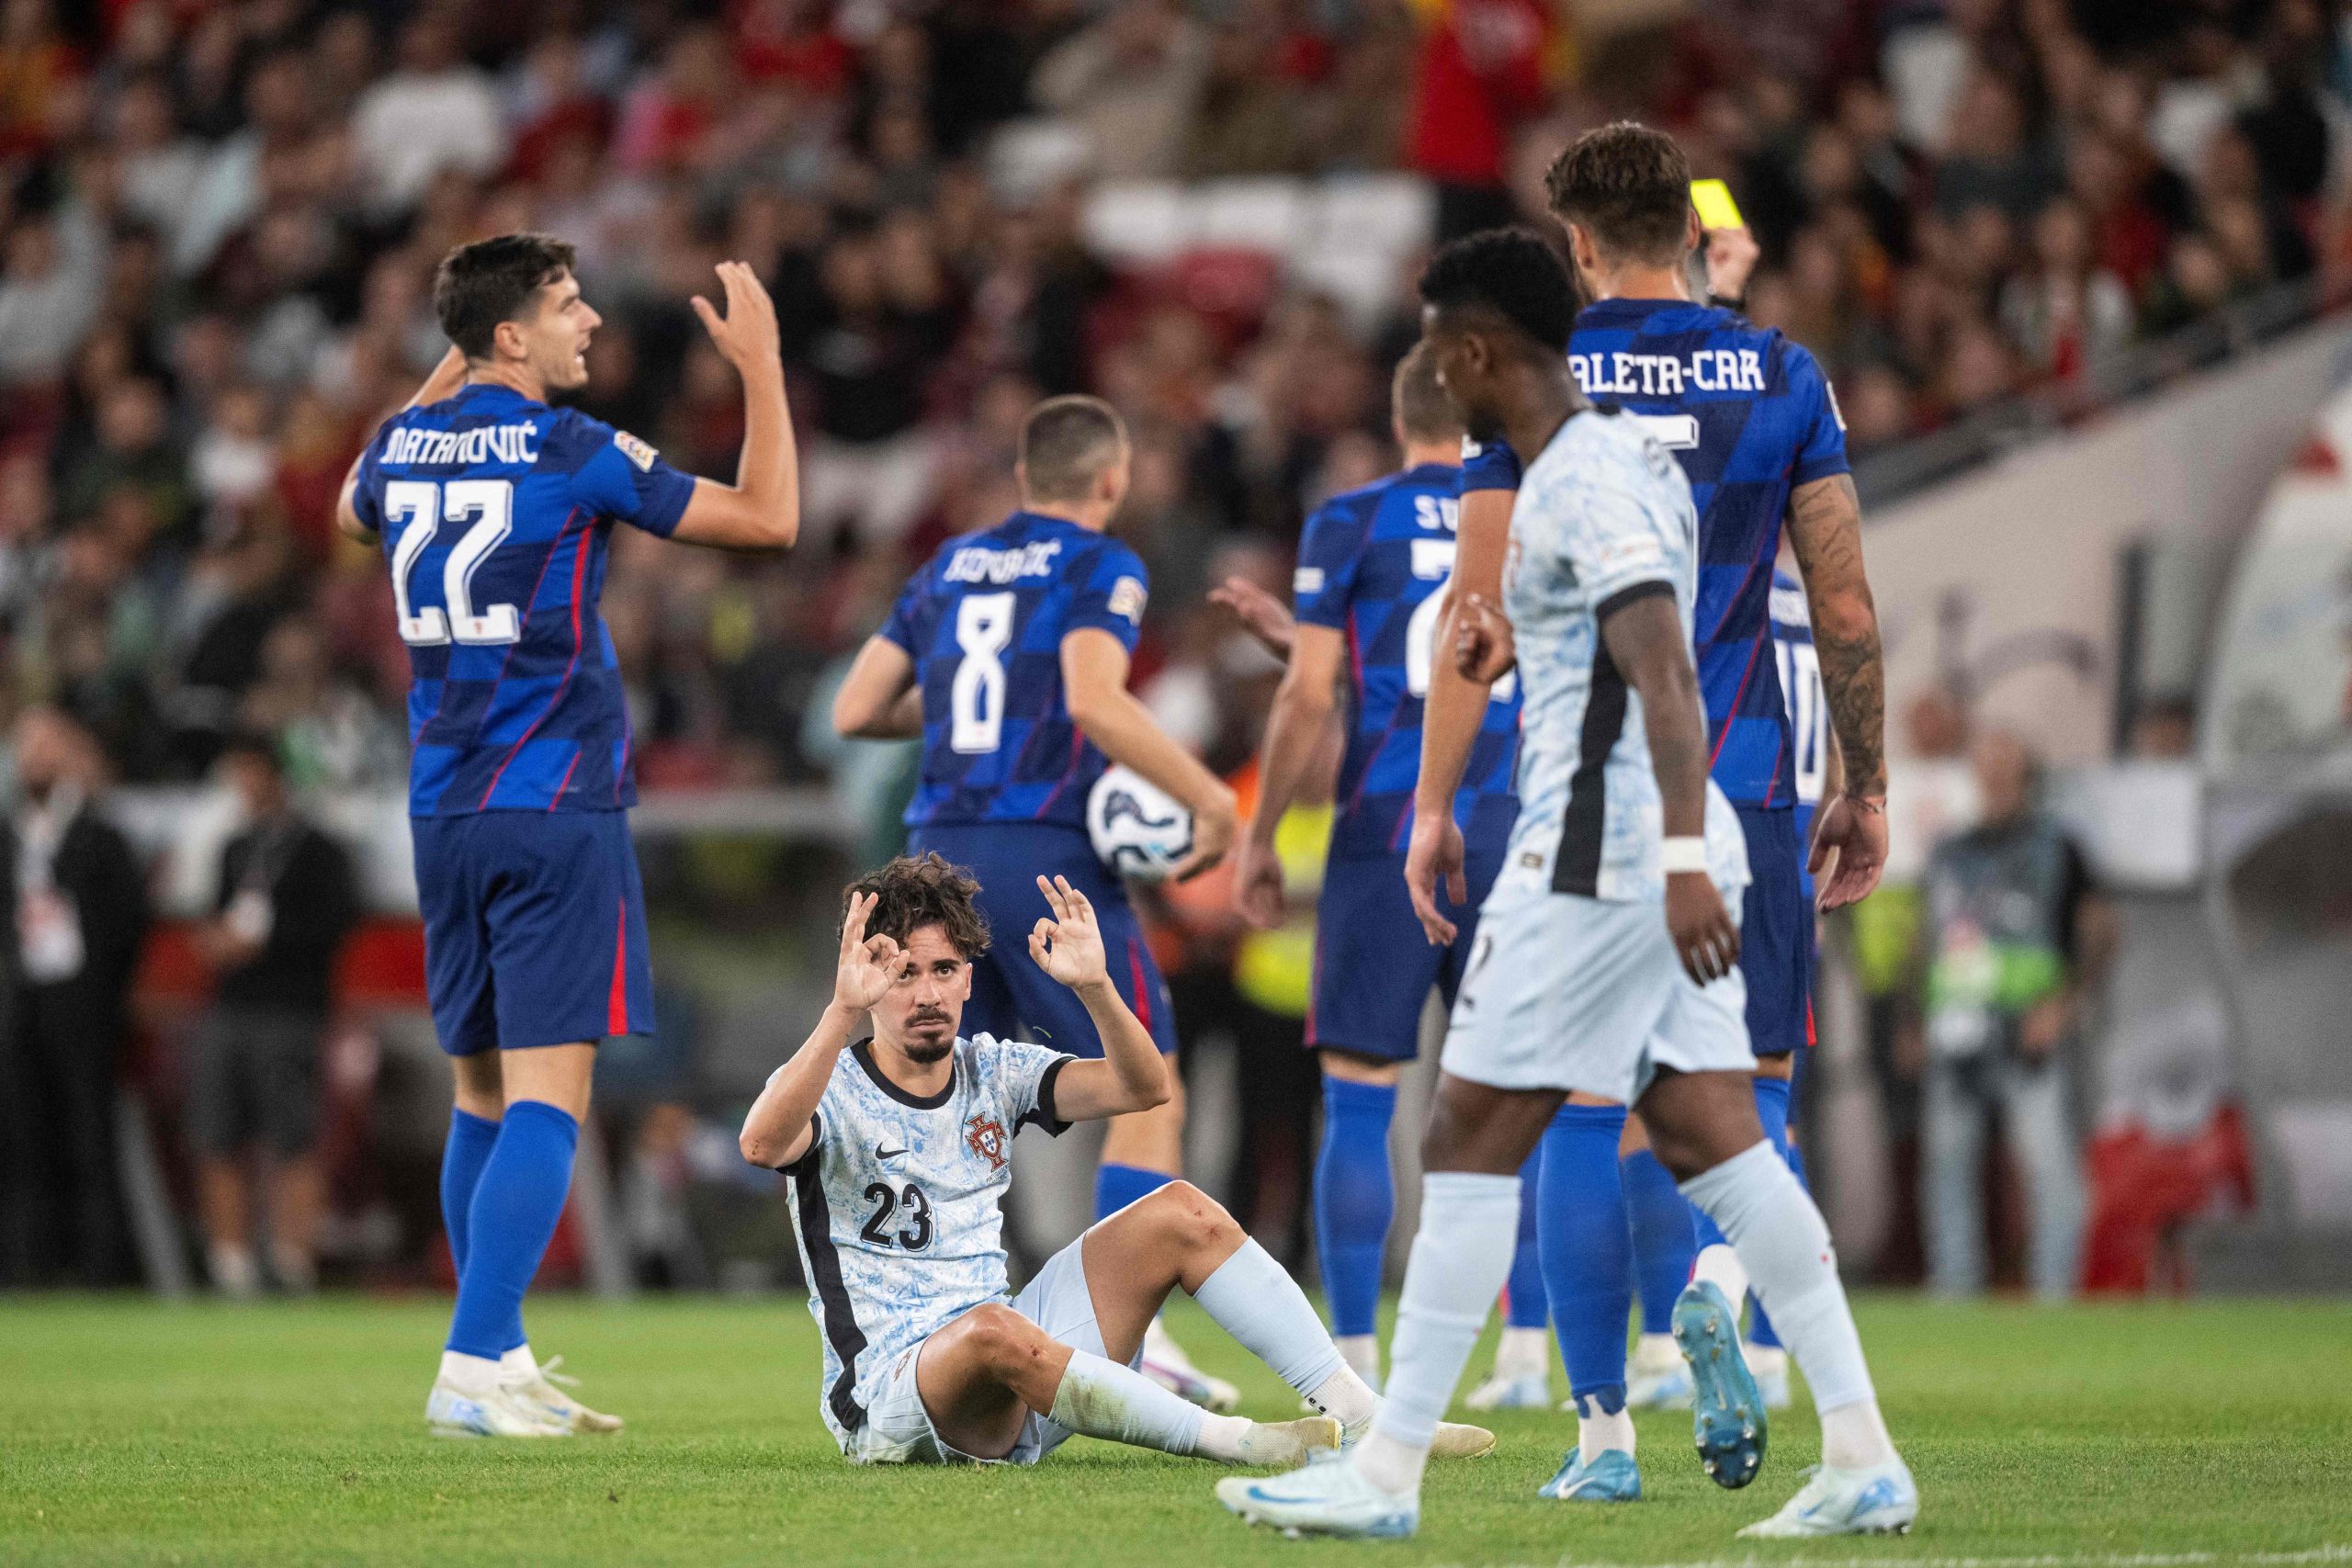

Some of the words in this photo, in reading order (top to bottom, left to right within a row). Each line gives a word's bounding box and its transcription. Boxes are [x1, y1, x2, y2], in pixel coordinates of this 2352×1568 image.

[1567, 349, 1766, 395] ALETA-CAR
[384, 479, 521, 647] 22
[951, 591, 1016, 754] 8
[859, 1181, 933, 1252] 23
